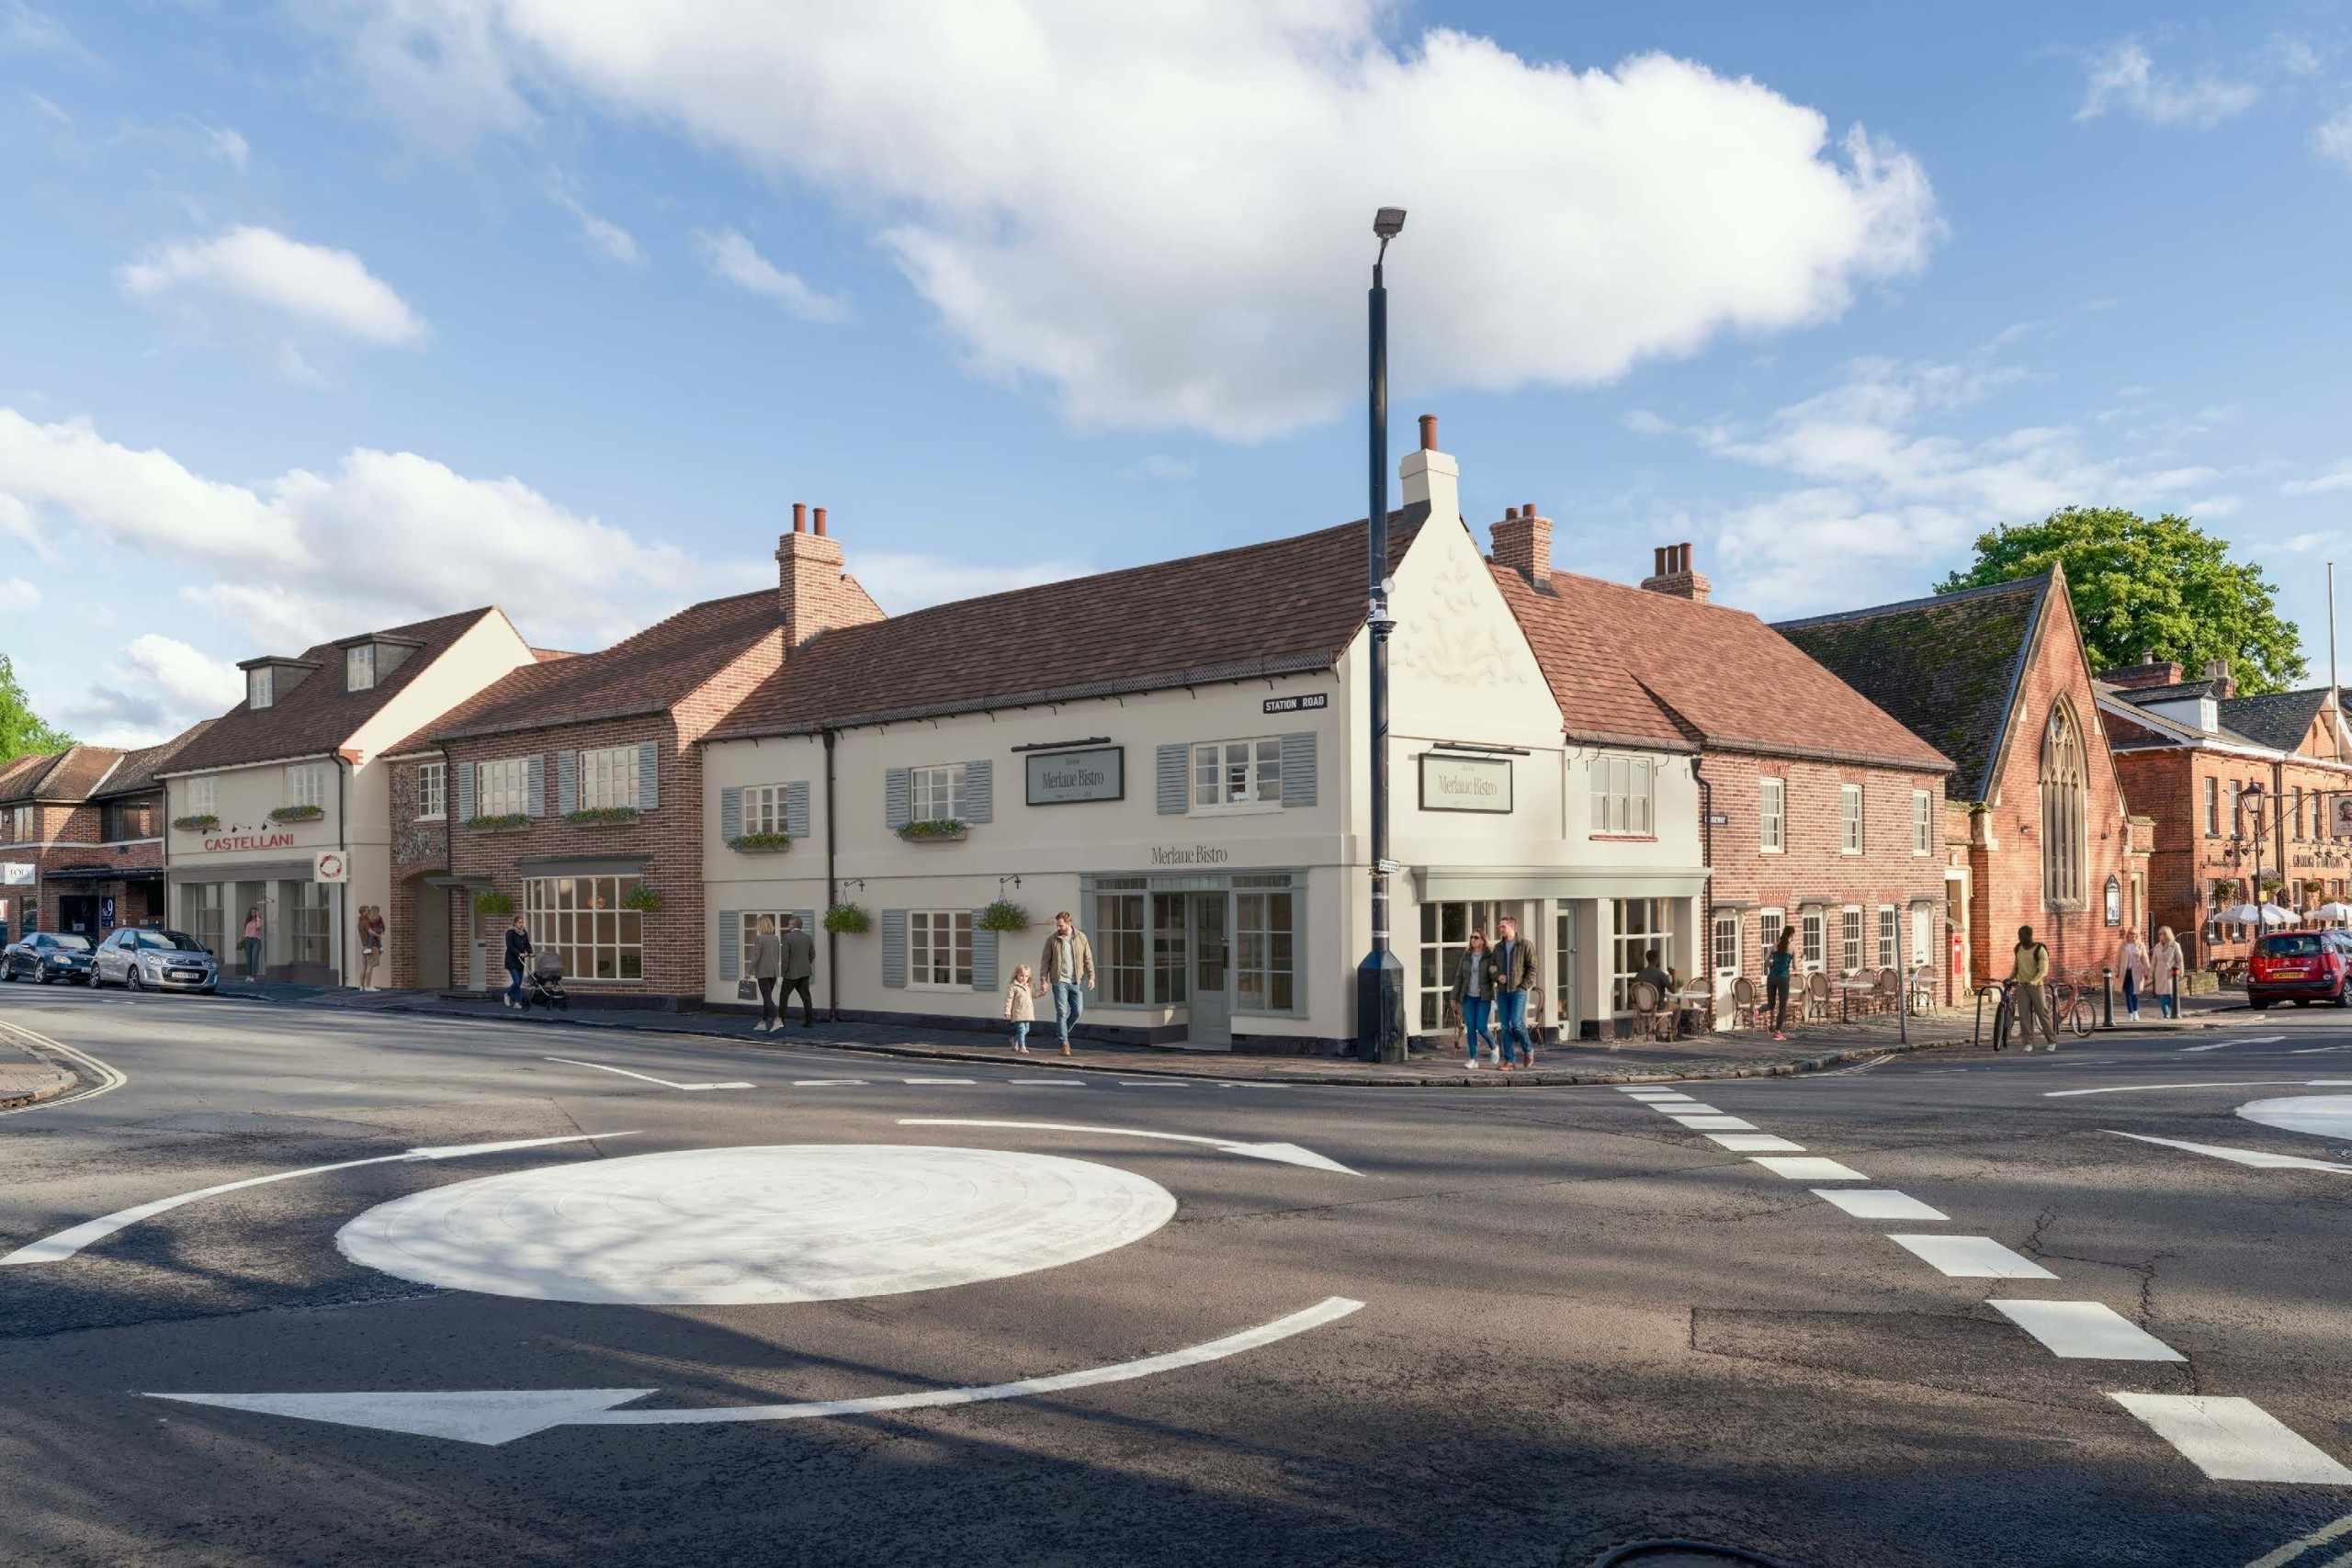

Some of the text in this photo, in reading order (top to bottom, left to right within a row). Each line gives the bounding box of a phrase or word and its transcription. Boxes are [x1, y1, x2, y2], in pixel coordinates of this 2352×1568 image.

[1265, 695, 1325, 711] STATION ROAD
[1042, 769, 1104, 790] Merlaue Bistro
[1473, 777, 1498, 796] Bistro
[204, 833, 294, 852] CASTELLANI
[1151, 845, 1227, 864] Merlaue Bistro
